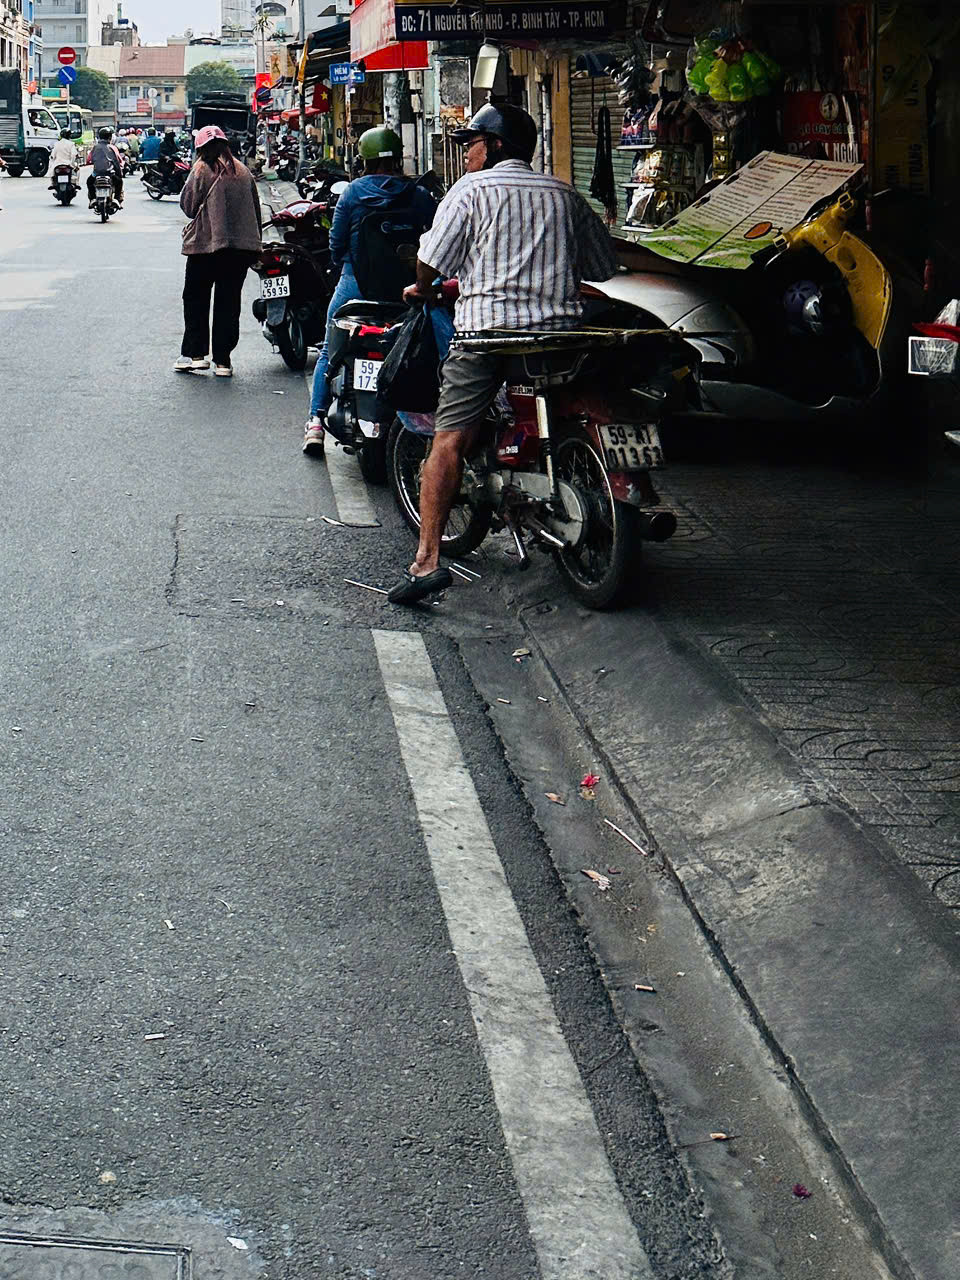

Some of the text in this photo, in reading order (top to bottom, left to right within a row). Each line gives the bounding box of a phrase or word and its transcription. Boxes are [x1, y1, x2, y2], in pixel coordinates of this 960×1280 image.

[401, 14, 417, 32] ĐC:
[418, 9, 431, 32] 71
[434, 8, 468, 31] NGUYỄN
[512, 13, 521, 30] P.
[522, 9, 543, 30] BÌNH
[545, 8, 560, 29] TÂY
[569, 11, 583, 28] TP.
[584, 10, 605, 28] HCM
